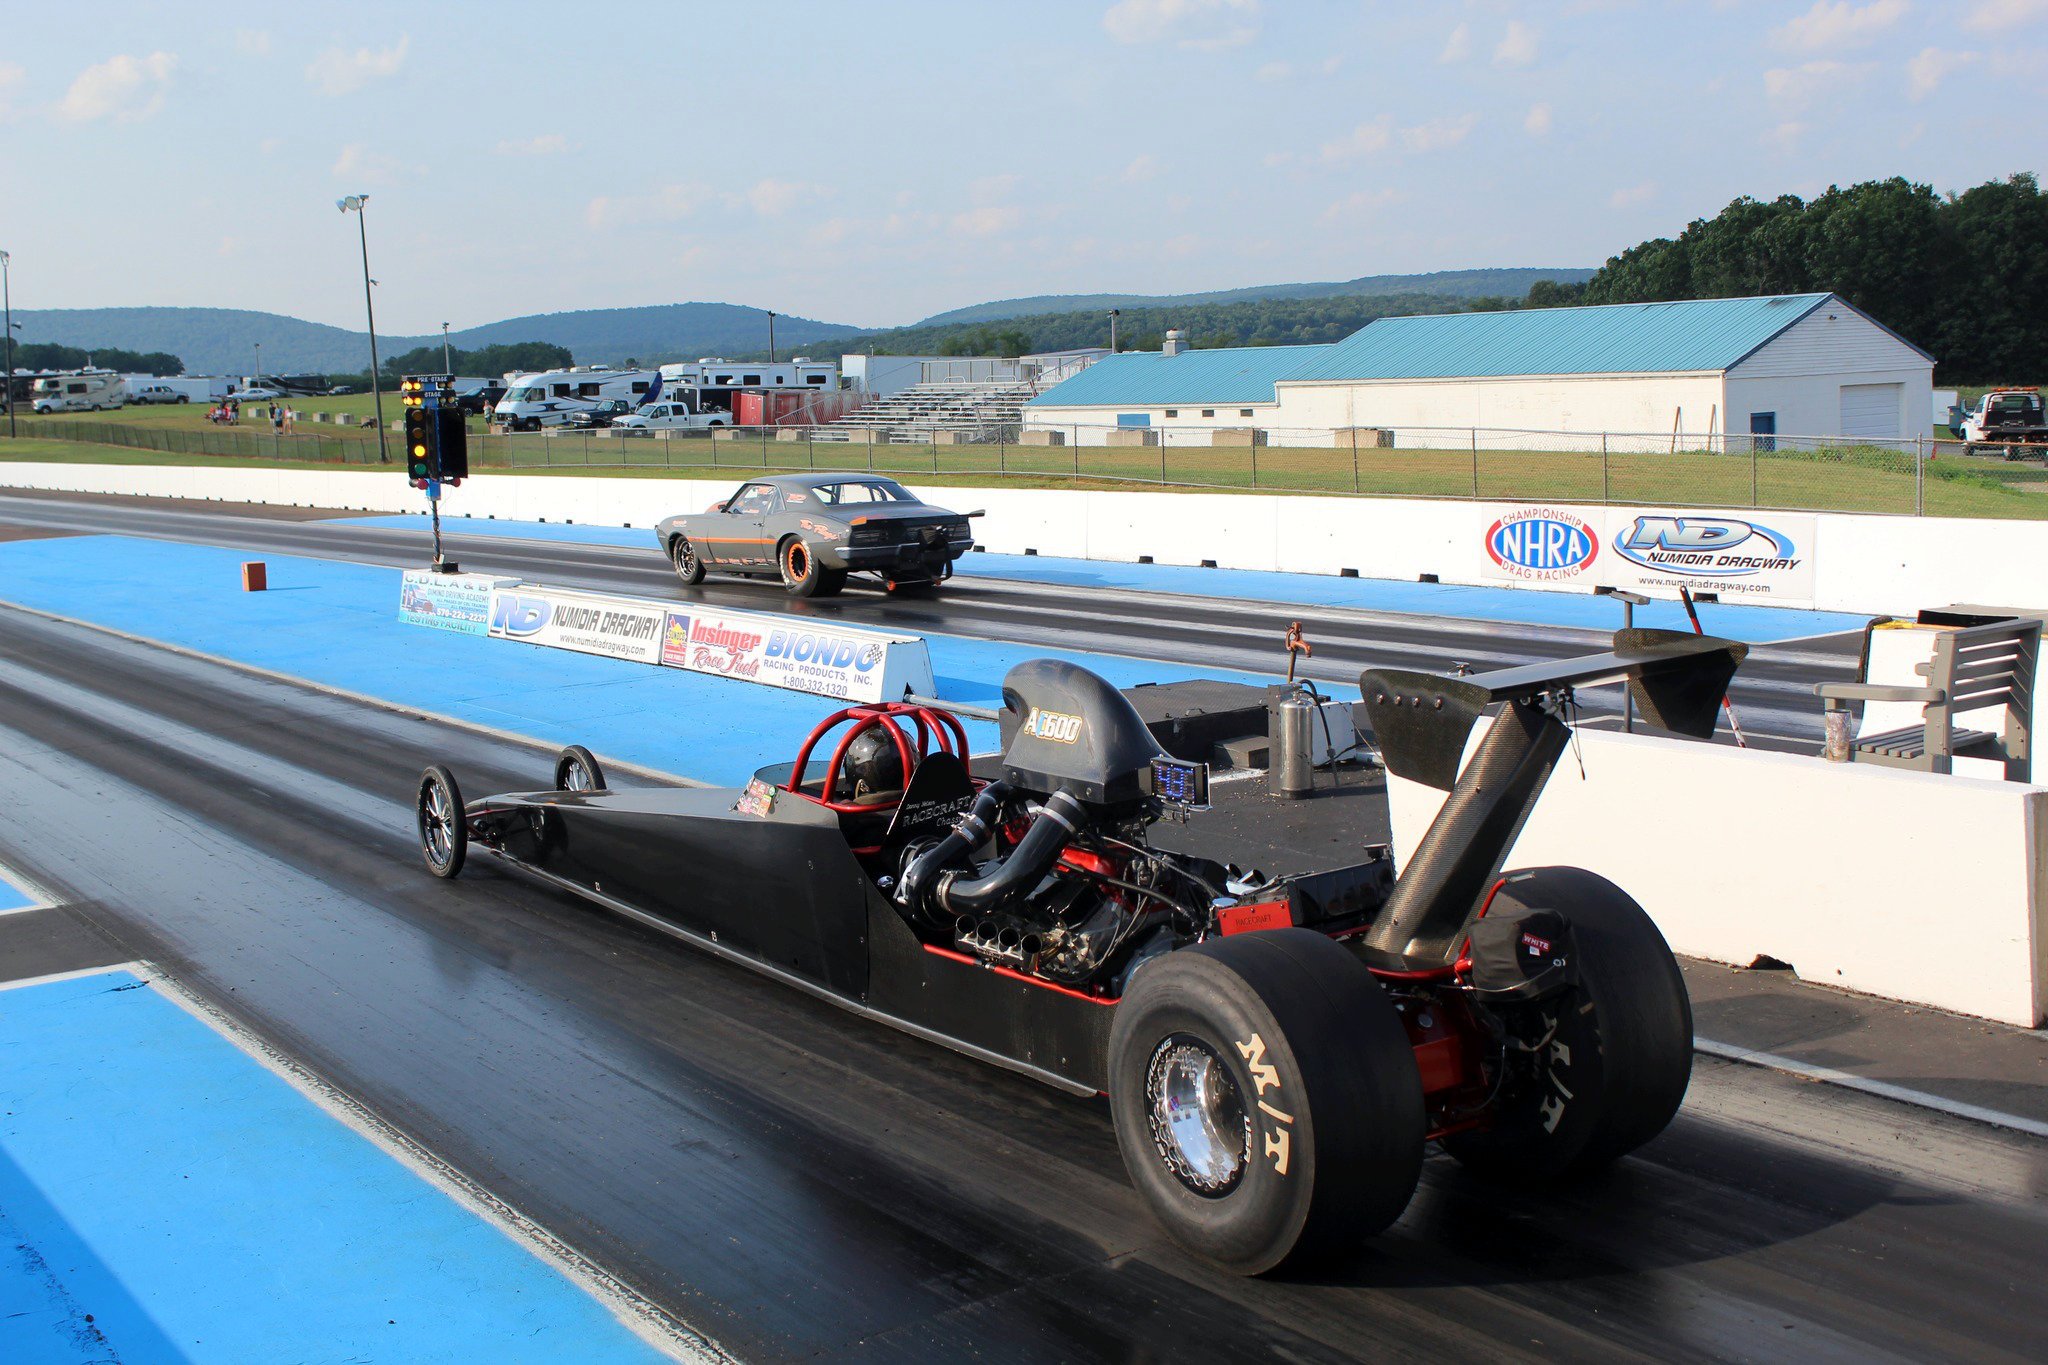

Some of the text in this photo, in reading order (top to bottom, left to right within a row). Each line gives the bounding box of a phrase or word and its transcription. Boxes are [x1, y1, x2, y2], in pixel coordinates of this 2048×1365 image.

[1503, 508, 1582, 527] CHAMPIONSHIP
[1503, 521, 1583, 568] NHRA
[1624, 516, 1753, 552] ND
[1501, 560, 1532, 579] DRAG
[1536, 565, 1580, 581] RACING
[1646, 552, 1801, 570] NUMIDIA DRAGWAY
[405, 573, 489, 592] C.D.L. A & B
[1639, 577, 1771, 593] www.numidiadragway.com
[406, 614, 478, 633] TESTING FACILITY
[490, 594, 552, 637] ND
[552, 605, 661, 640] NUMIDIA DRAGWAY
[560, 634, 646, 655] www.numidiadragway.com
[690, 619, 762, 655] Insinger
[692, 646, 760, 677] Race Fuels
[765, 629, 877, 673] BIONDO
[763, 659, 873, 686] RACING PRODUCTS, INC.
[783, 676, 848, 697] 1-800-332-1320
[902, 795, 971, 828] RACECRAFT
[1236, 914, 1272, 926] RACECRAFT
[1523, 934, 1550, 950] WHITE
[1146, 1037, 1172, 1101] RACING
[1235, 1032, 1295, 1177] M/T
